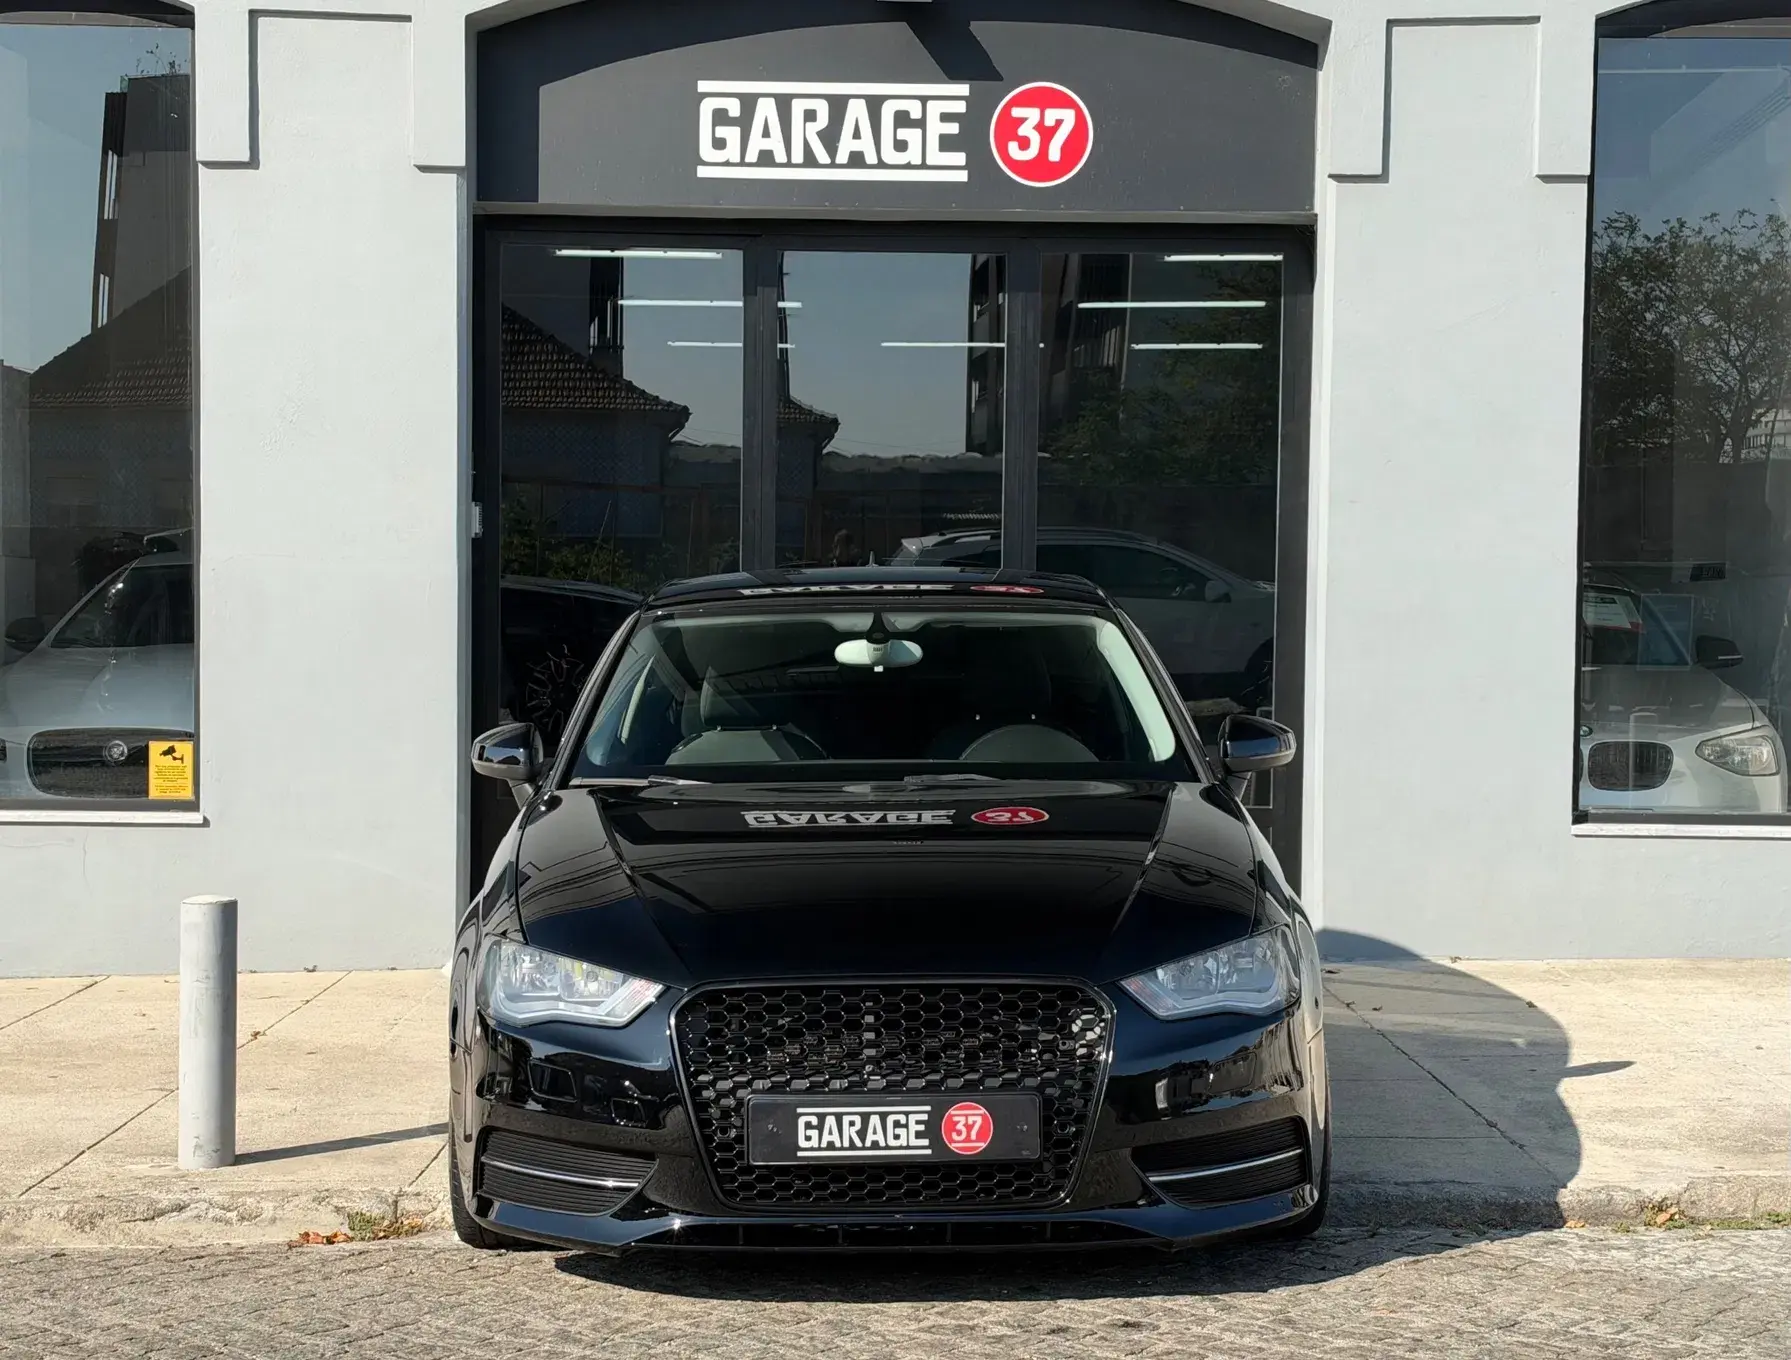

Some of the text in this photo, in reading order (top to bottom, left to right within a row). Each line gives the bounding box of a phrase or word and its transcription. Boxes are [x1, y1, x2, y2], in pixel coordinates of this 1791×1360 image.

[699, 97, 1076, 166] GARAGE 37
[797, 1113, 983, 1148] GARAGE 37
